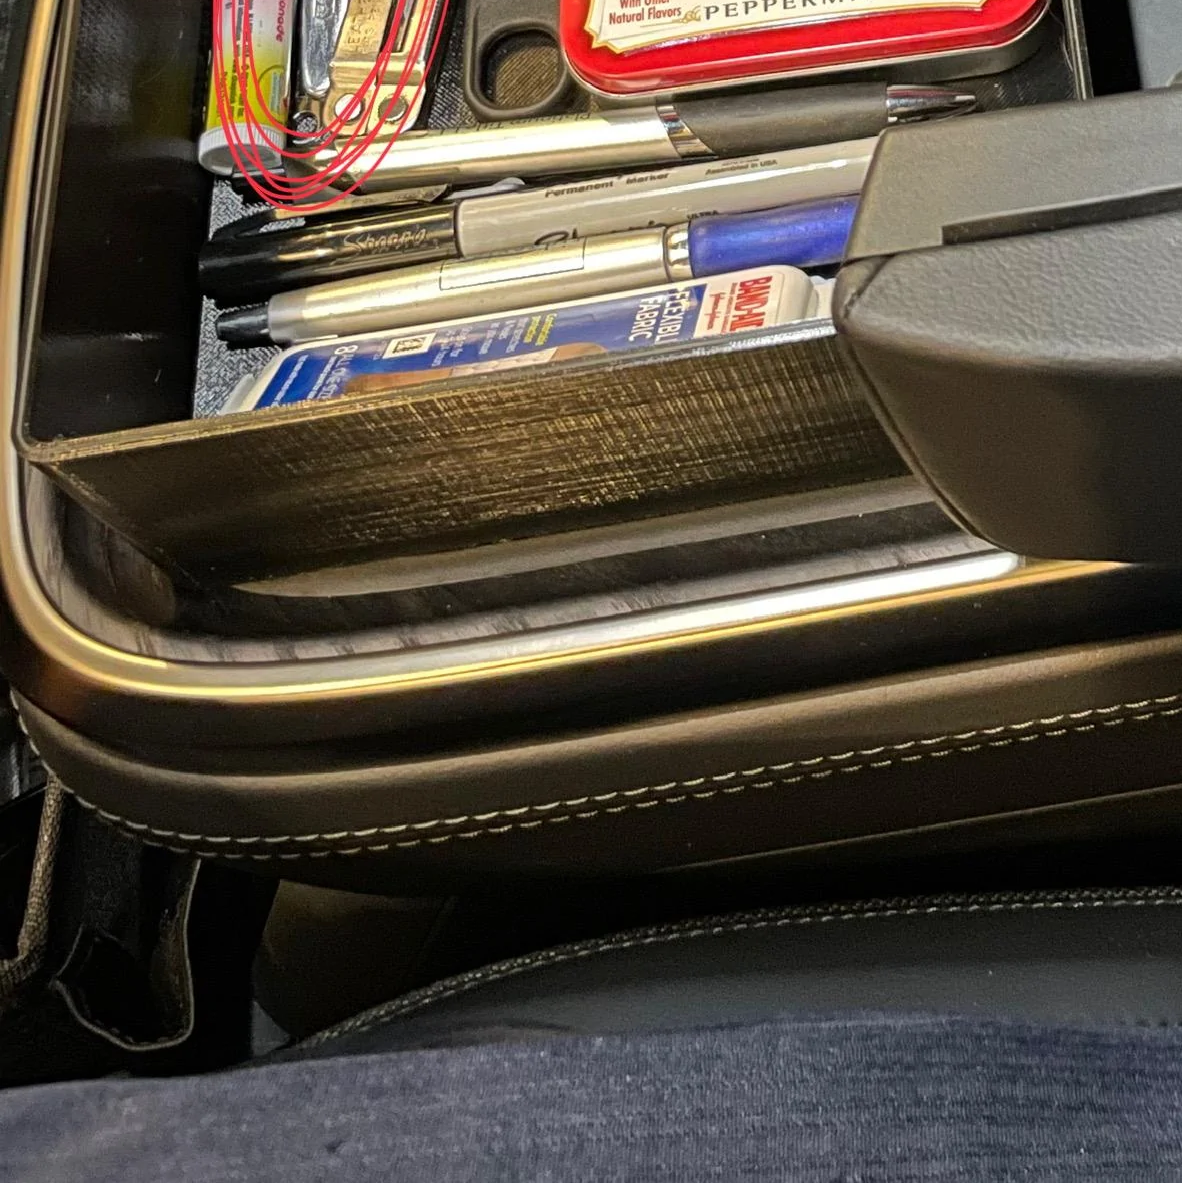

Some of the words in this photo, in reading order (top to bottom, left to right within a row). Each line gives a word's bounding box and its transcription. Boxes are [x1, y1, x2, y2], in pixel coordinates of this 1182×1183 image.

[608, 9, 645, 26] Natural
[647, 6, 682, 21] Flavors
[544, 180, 614, 198] Permanent
[625, 172, 670, 186] Marker
[628, 297, 662, 342] FABRIC
